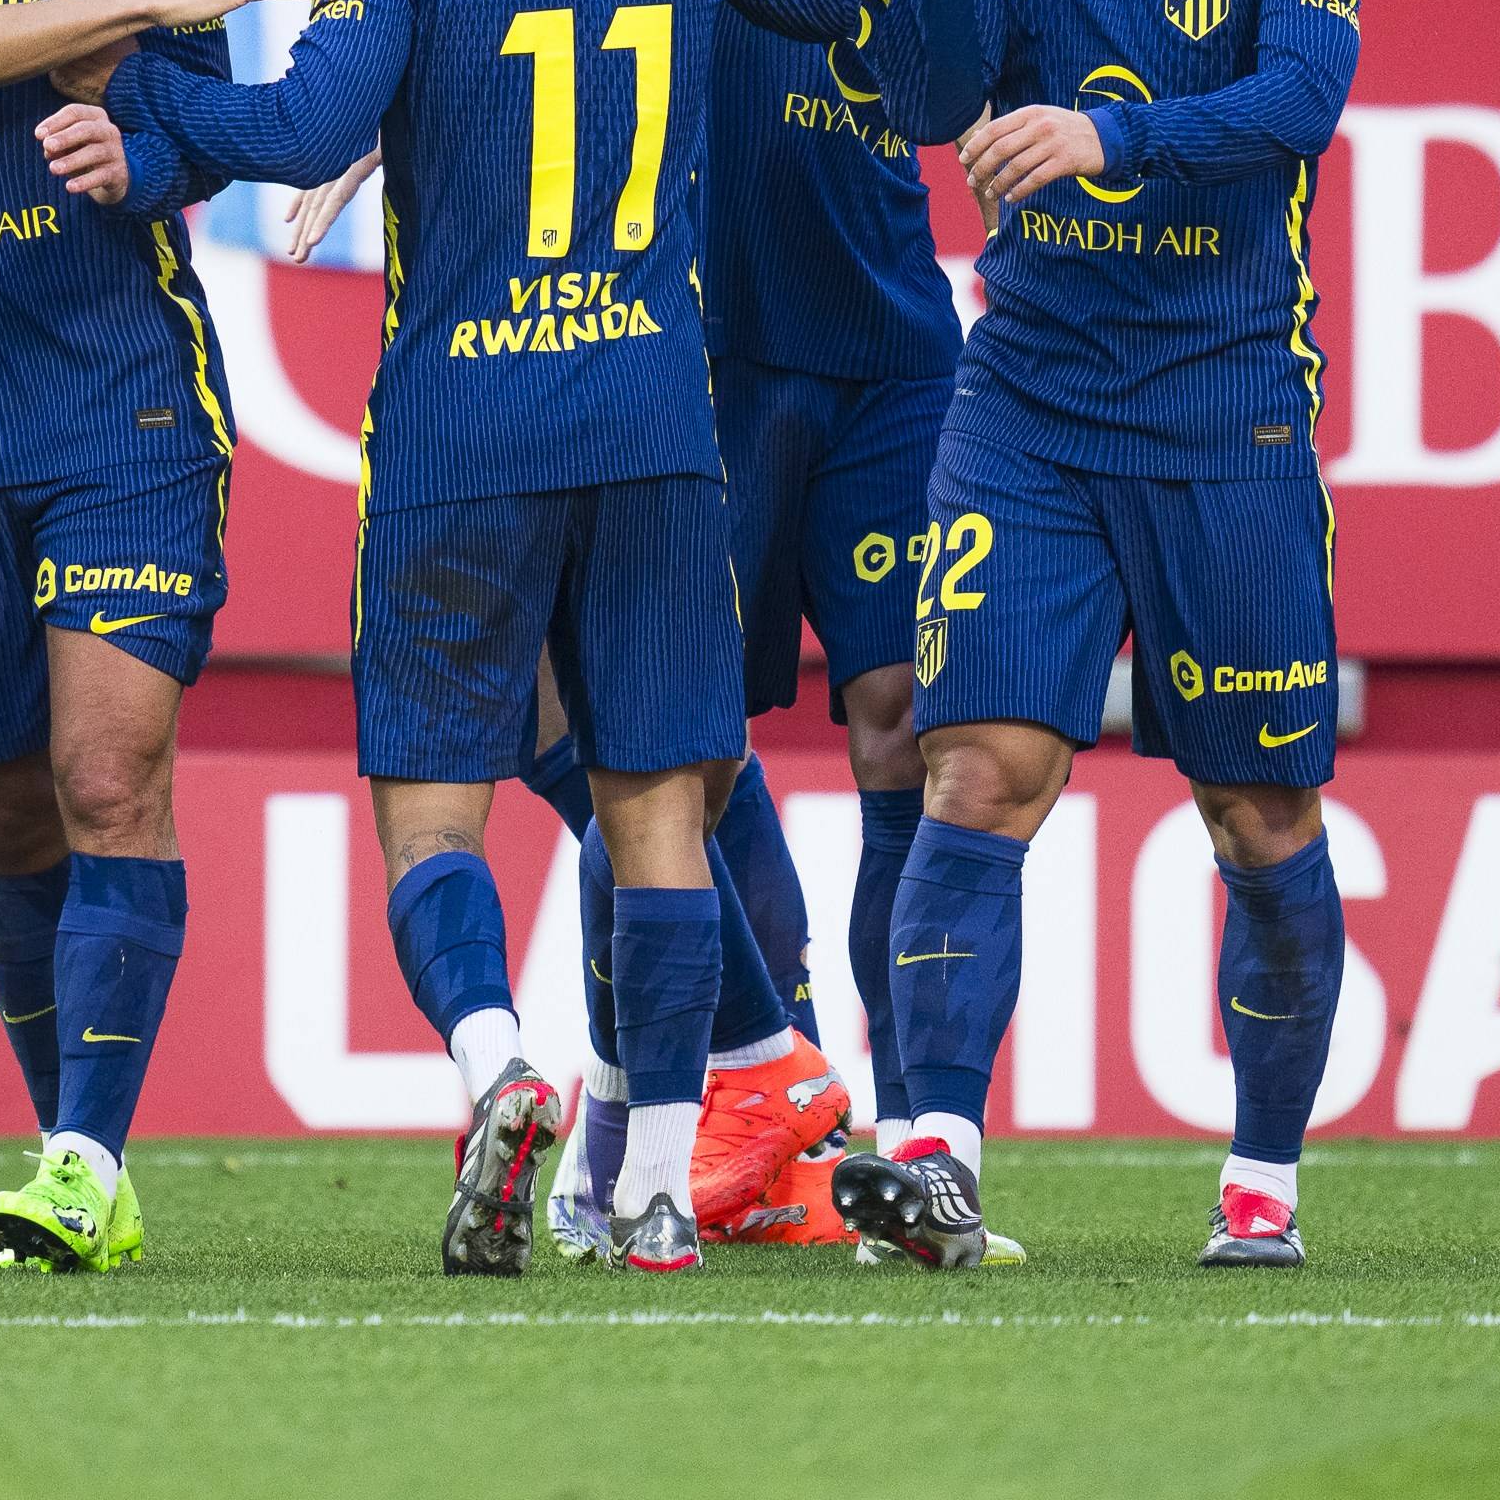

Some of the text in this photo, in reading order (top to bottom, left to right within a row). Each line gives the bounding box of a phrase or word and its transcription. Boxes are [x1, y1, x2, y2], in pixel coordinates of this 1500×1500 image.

[500, 3, 673, 259] 11
[1020, 209, 1220, 257] RIYADH AIR
[509, 271, 621, 314] VISIT
[449, 295, 662, 359] RWANDA
[64, 563, 193, 597] ComAve
[915, 512, 994, 621] 22
[1213, 660, 1327, 693] ComAve
